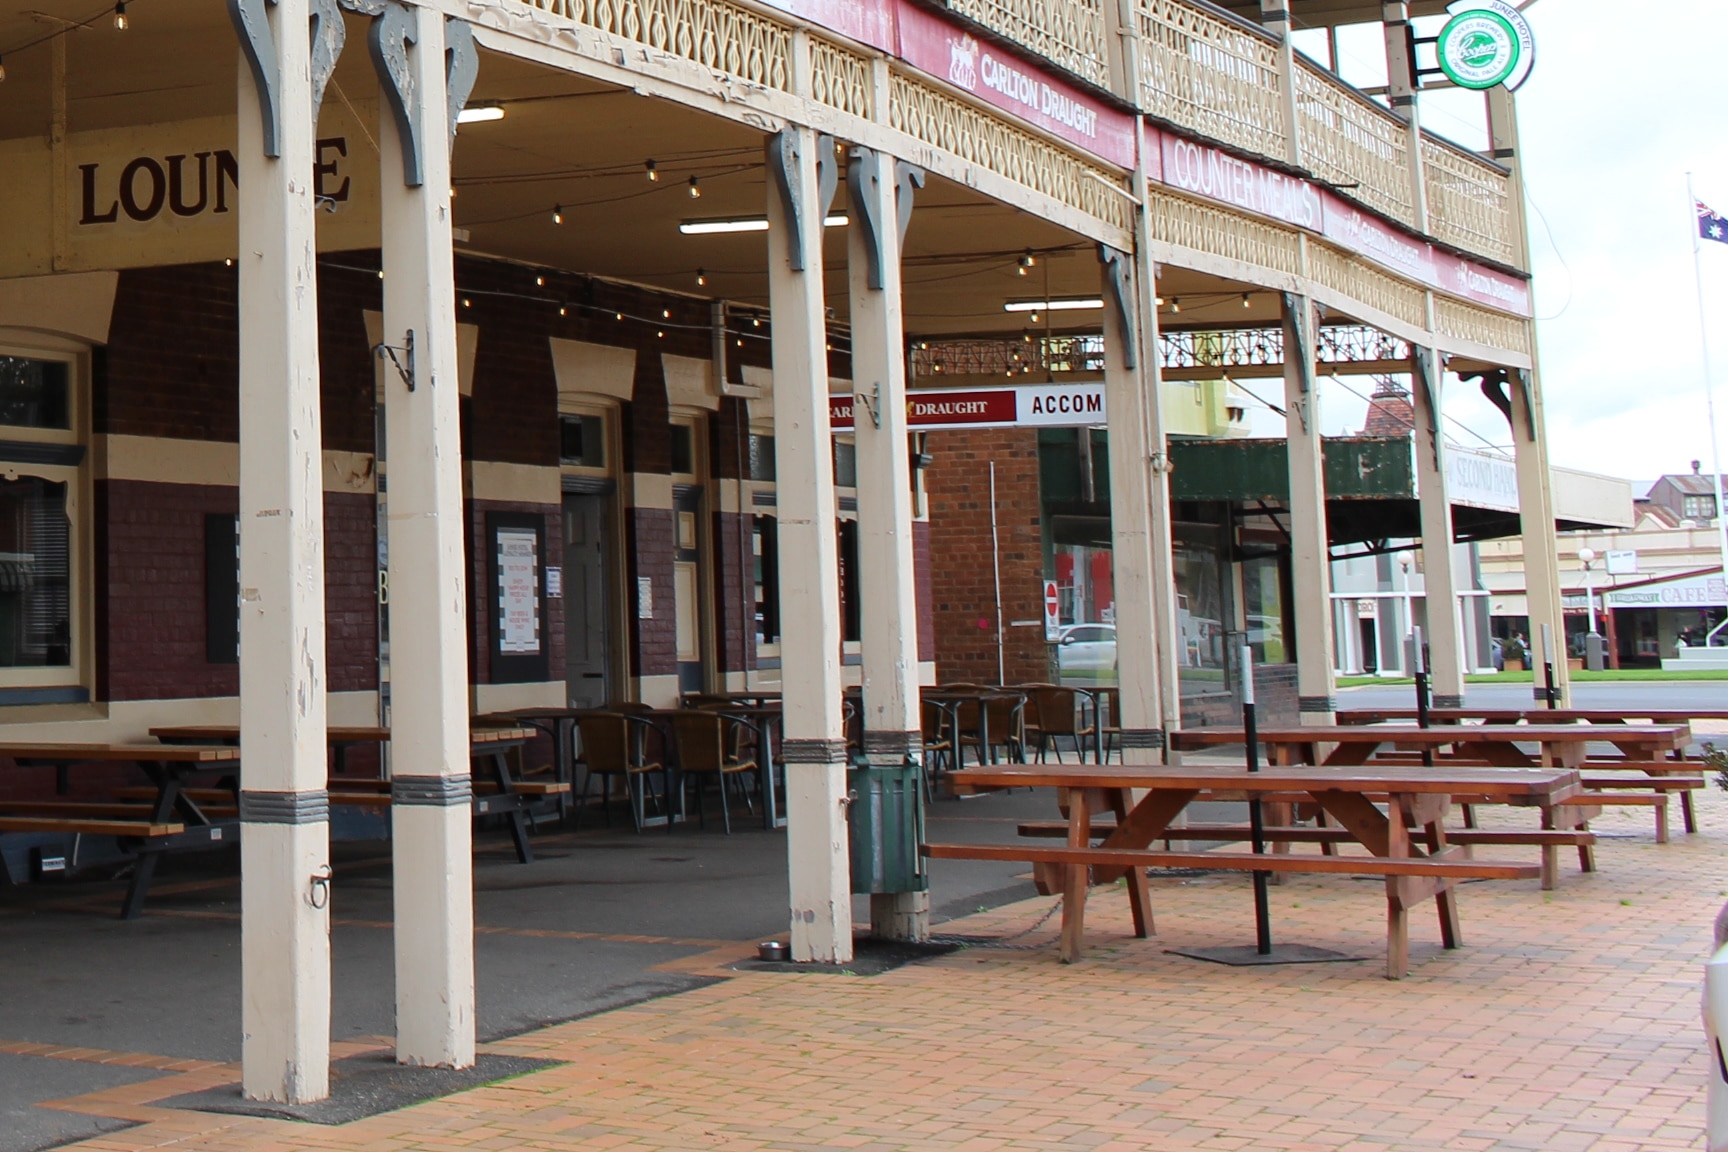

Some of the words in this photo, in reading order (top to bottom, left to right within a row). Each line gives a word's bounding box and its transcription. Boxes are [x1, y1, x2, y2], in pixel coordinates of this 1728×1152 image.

[1489, 0, 1518, 23] JUNEE
[1516, 21, 1531, 51] HOTEL
[980, 53, 1040, 111] CARLTON
[1041, 82, 1097, 139] DRAUGHT
[78, 137, 351, 225] LOUNE
[1174, 138, 1256, 213] COUNTER
[1258, 166, 1313, 229] MEALS
[915, 400, 988, 416] DRAUGHT
[1032, 393, 1102, 414] ACCOM
[1661, 587, 1706, 603] CAFE
